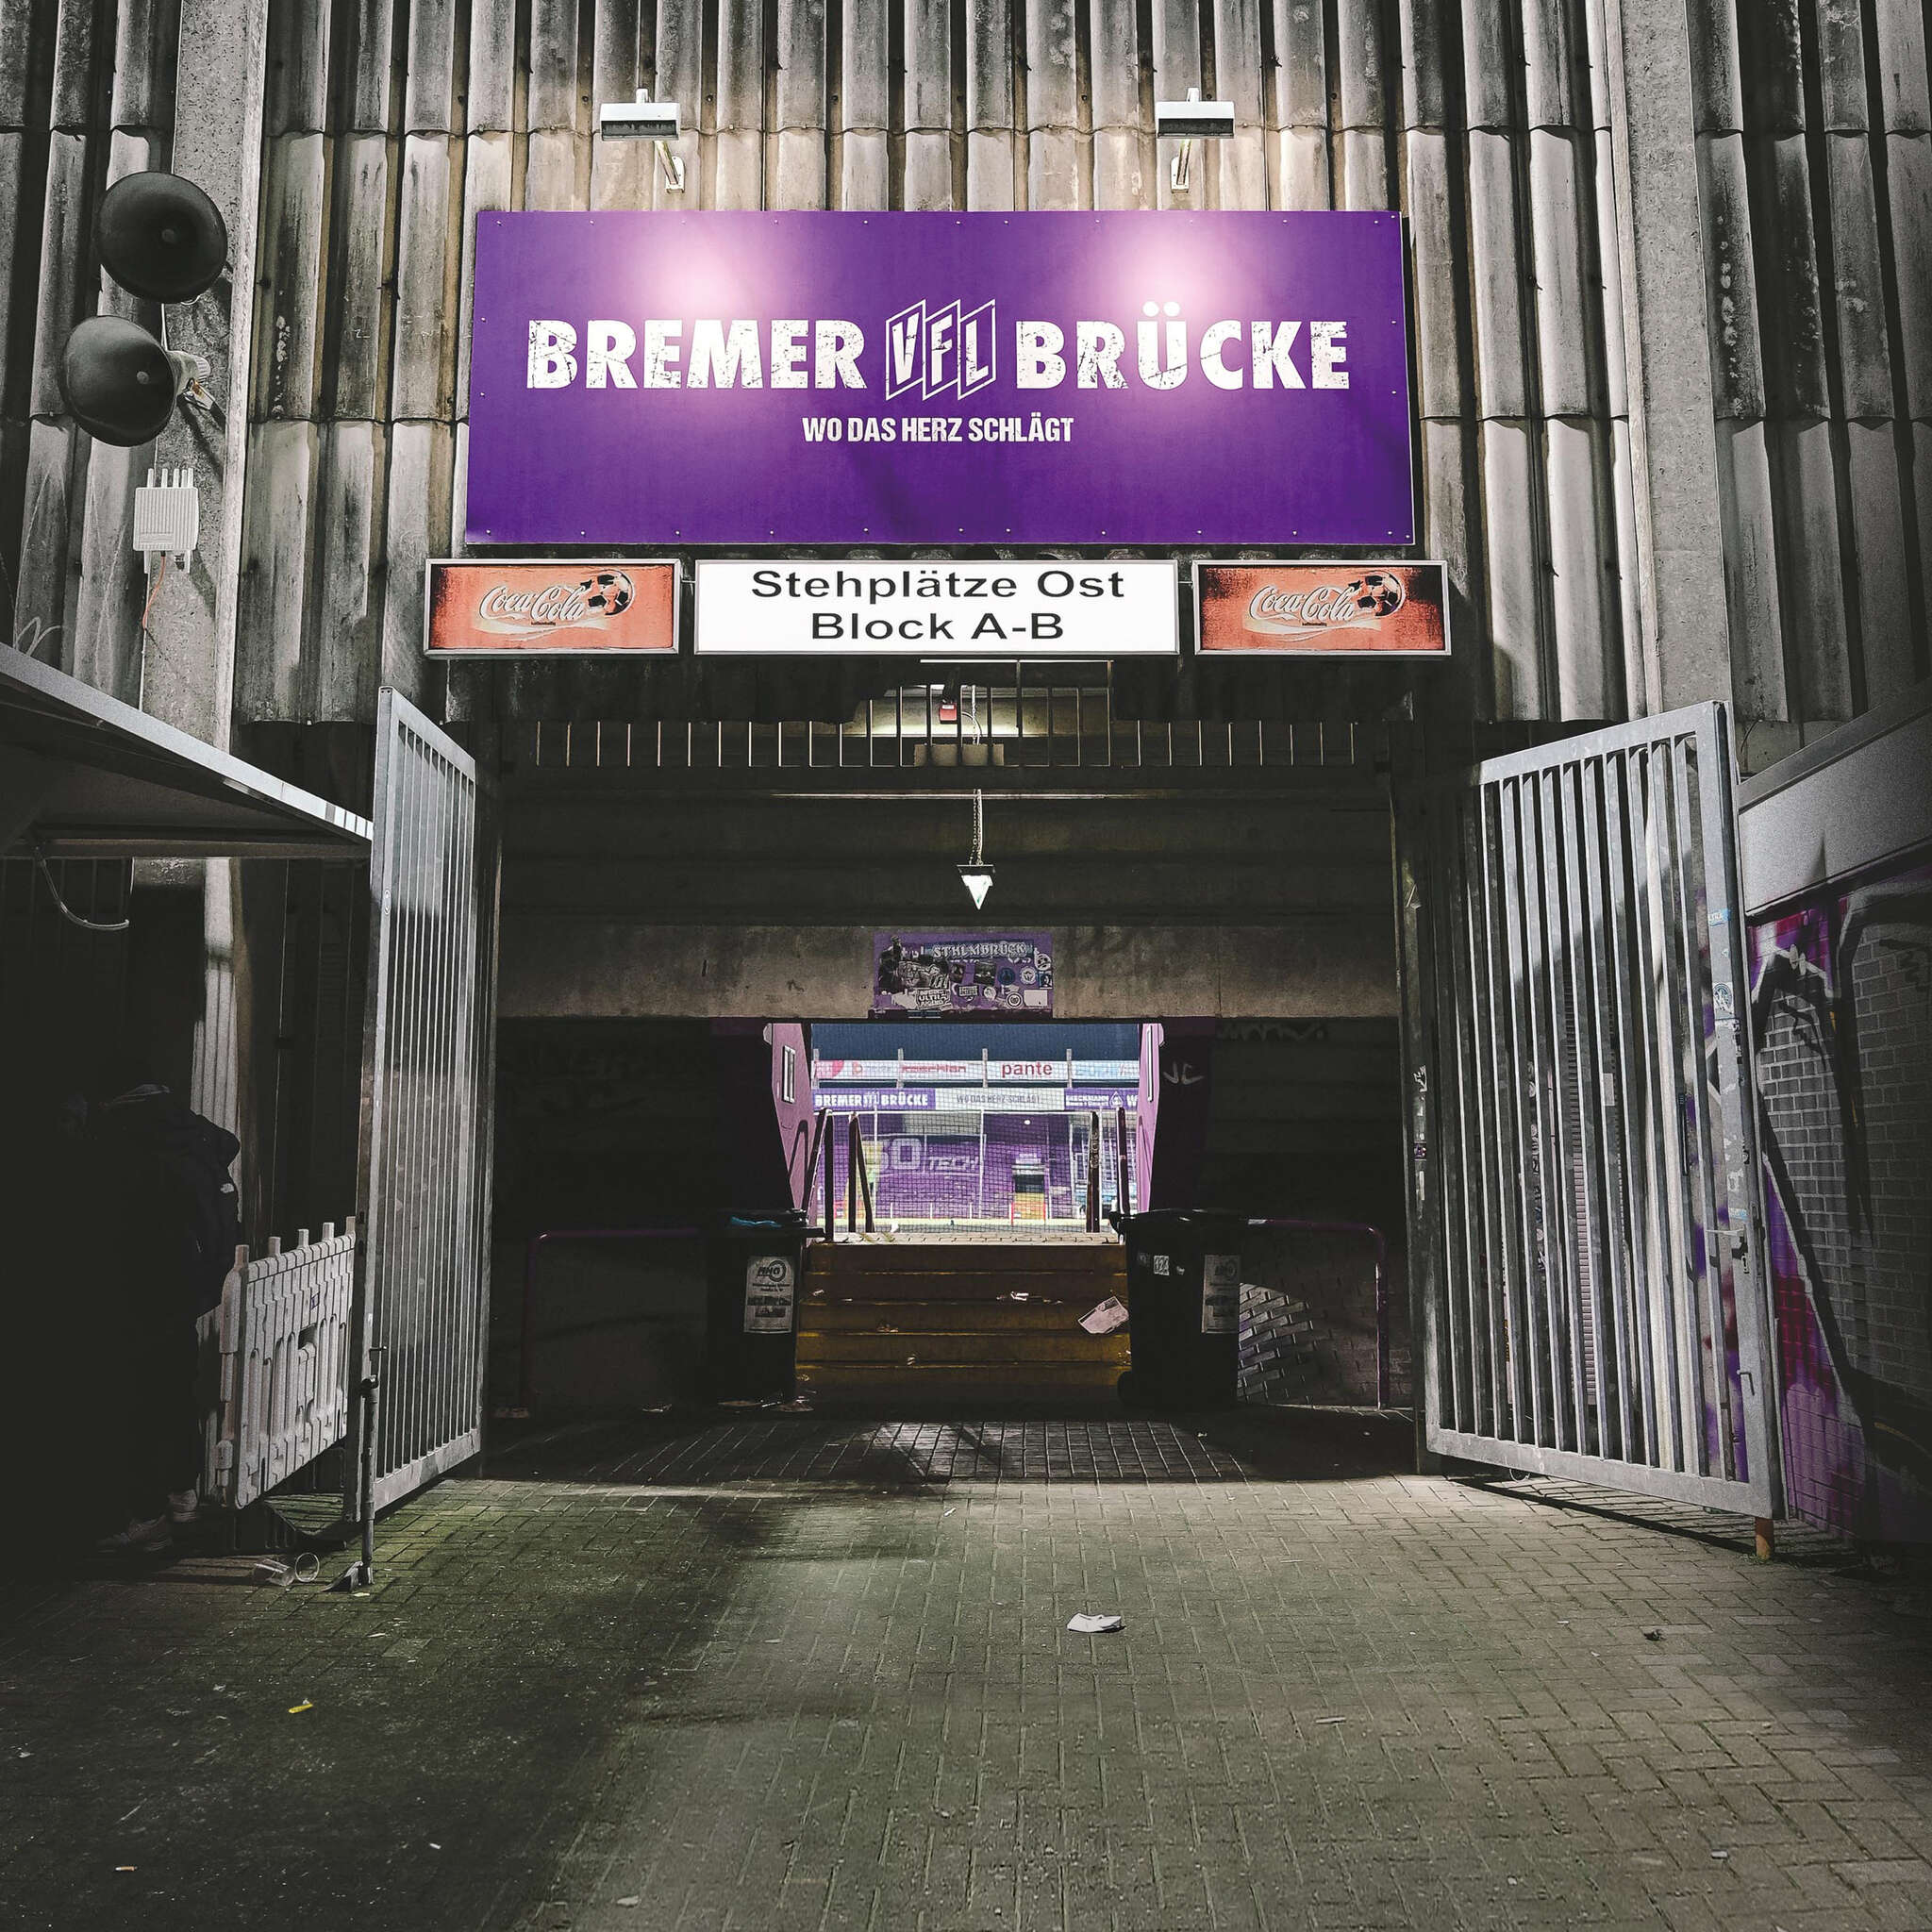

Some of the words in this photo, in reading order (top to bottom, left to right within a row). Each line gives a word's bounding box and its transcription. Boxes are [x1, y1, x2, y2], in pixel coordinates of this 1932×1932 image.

[527, 319, 868, 390] BREMER
[1015, 301, 1350, 391] BRÜCKE
[802, 417, 842, 441] WO
[848, 417, 896, 441] DAS
[902, 417, 962, 441] HERZ
[968, 411, 1074, 442] SCHLÄGT
[752, 570, 1017, 605] Stehplätze
[1037, 570, 1124, 598] Ost
[811, 613, 955, 640] Block
[971, 613, 1064, 640] A-B
[1002, 1061, 1053, 1078] pante
[815, 1093, 862, 1107] BREMER
[881, 1091, 928, 1106] BRÜCKE
